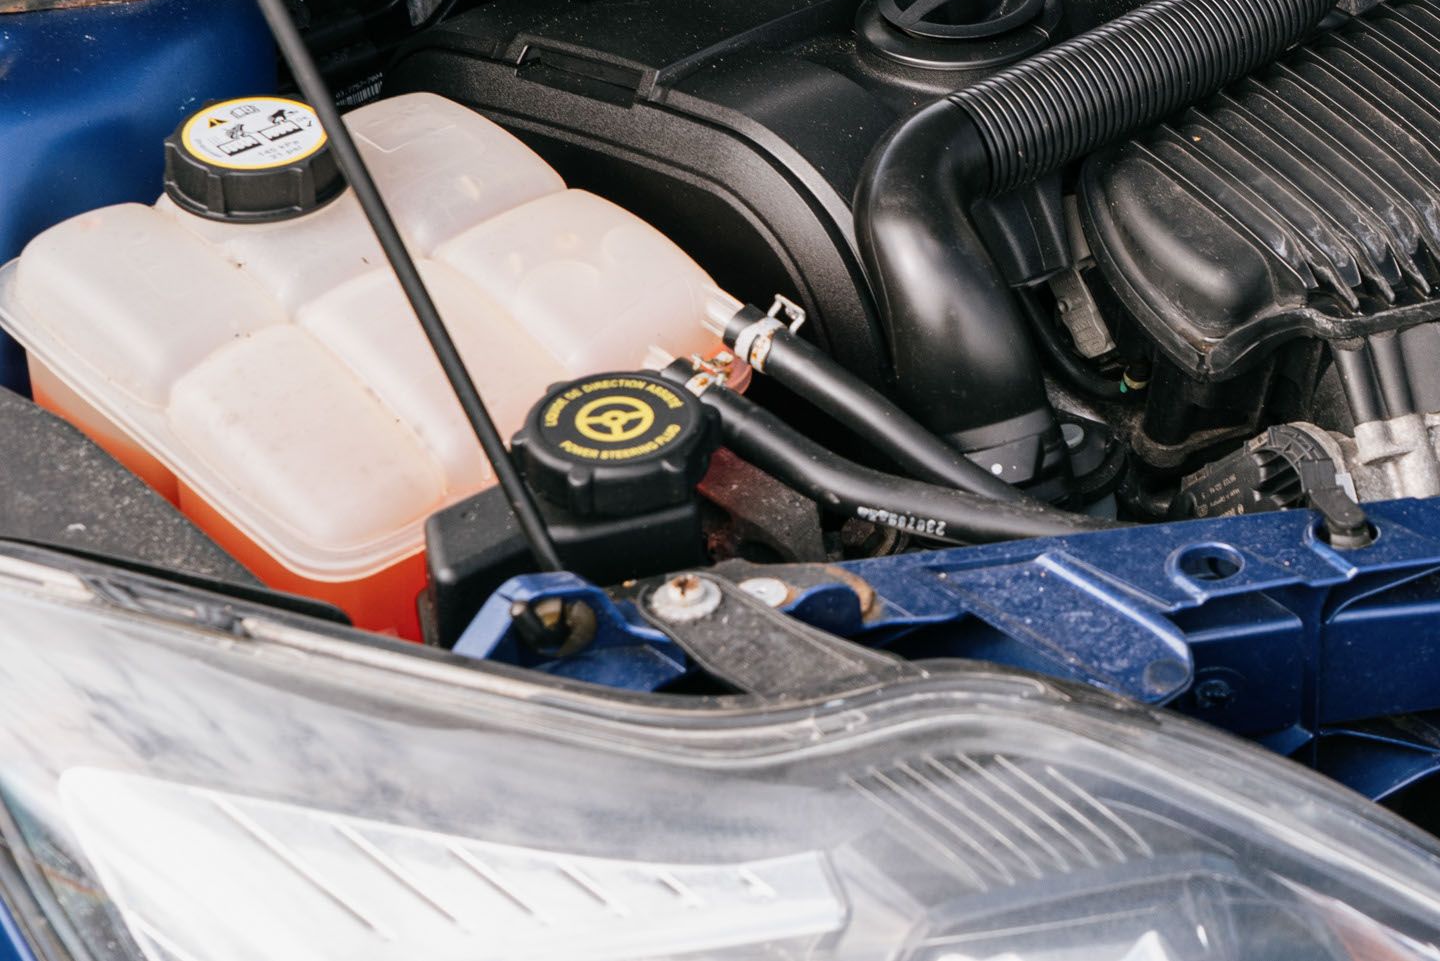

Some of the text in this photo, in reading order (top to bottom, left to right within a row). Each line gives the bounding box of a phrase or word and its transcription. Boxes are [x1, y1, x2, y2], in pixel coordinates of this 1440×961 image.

[564, 388, 583, 401] DE
[582, 379, 647, 393] DIRECTION
[559, 423, 681, 460] POWER STEERING FLUID
